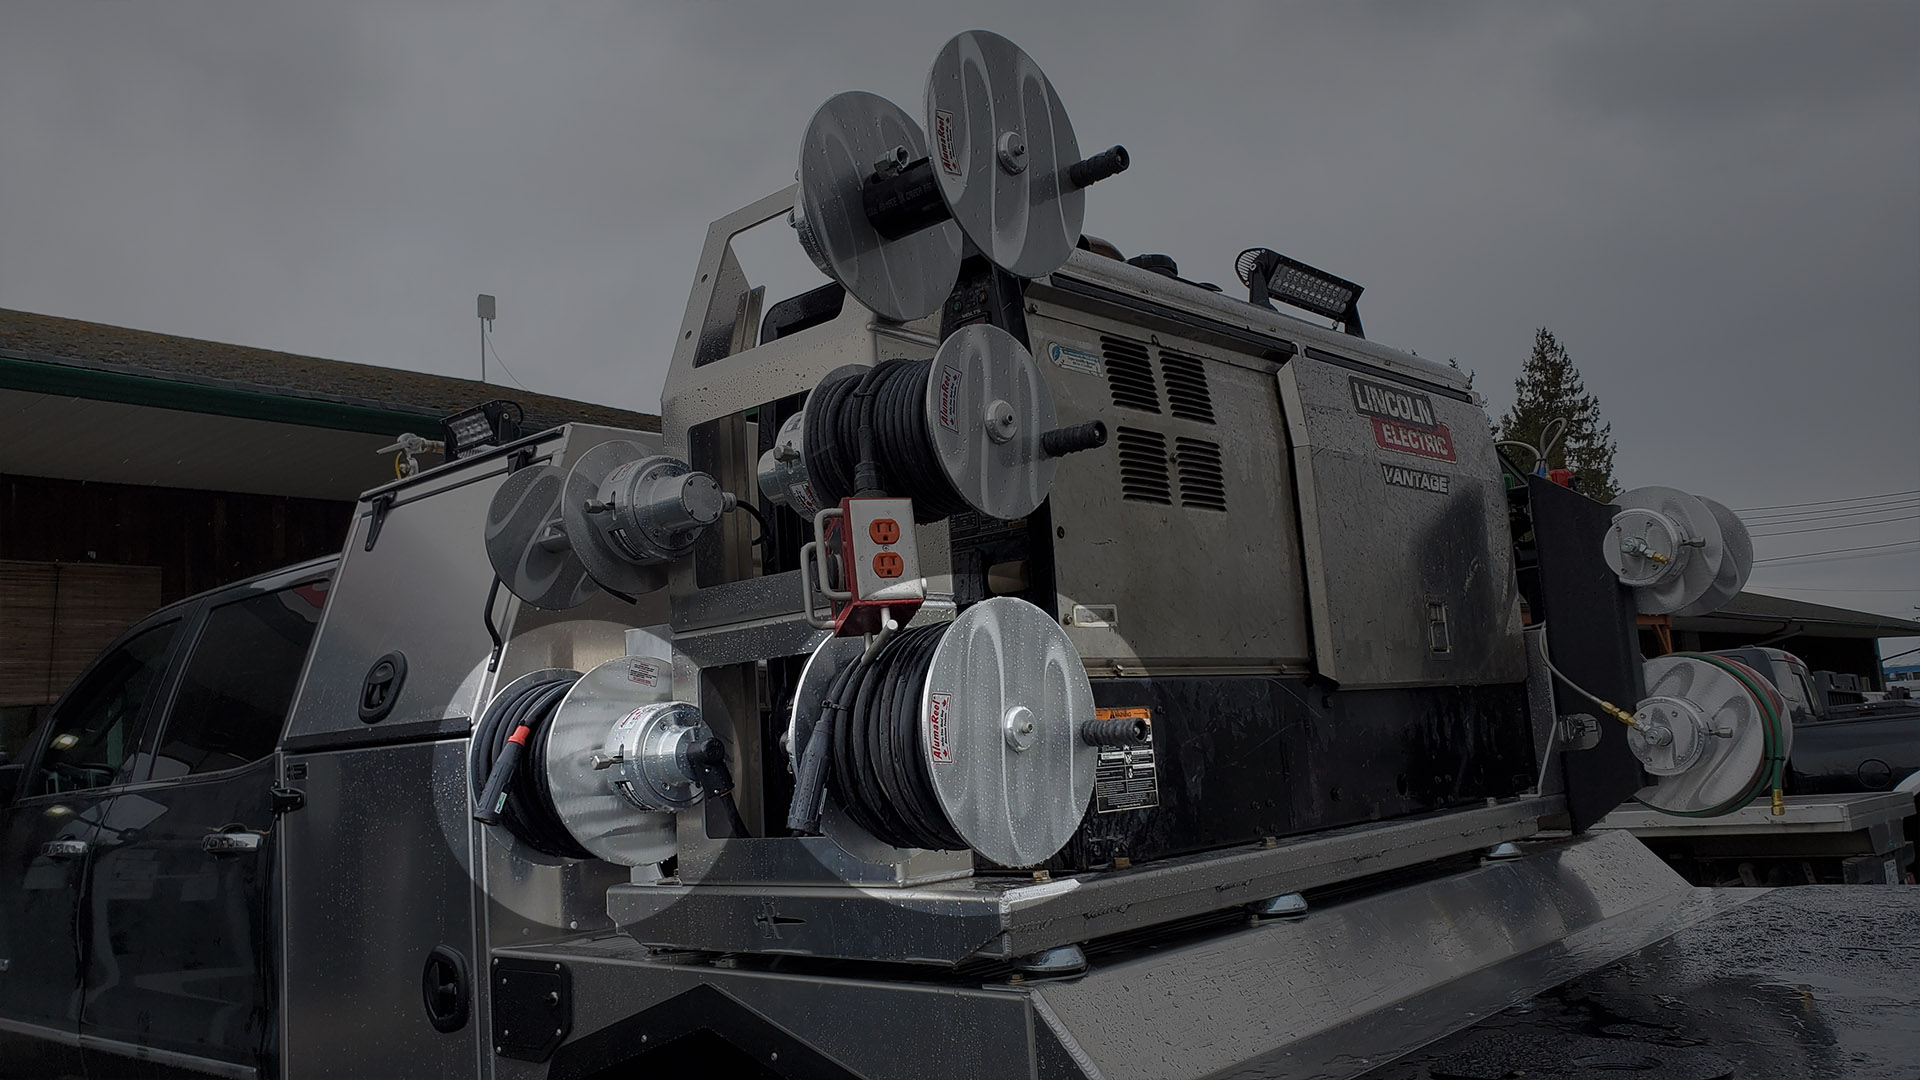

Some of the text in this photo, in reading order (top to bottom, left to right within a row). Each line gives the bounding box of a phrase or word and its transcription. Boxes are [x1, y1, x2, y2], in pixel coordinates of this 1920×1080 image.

[940, 370, 951, 426] AlumaReel
[1353, 382, 1434, 426] LINCOLN
[1382, 423, 1449, 456] ELECTRIC
[1382, 465, 1449, 494] VANTAGE
[931, 700, 943, 759] AlumaReel
